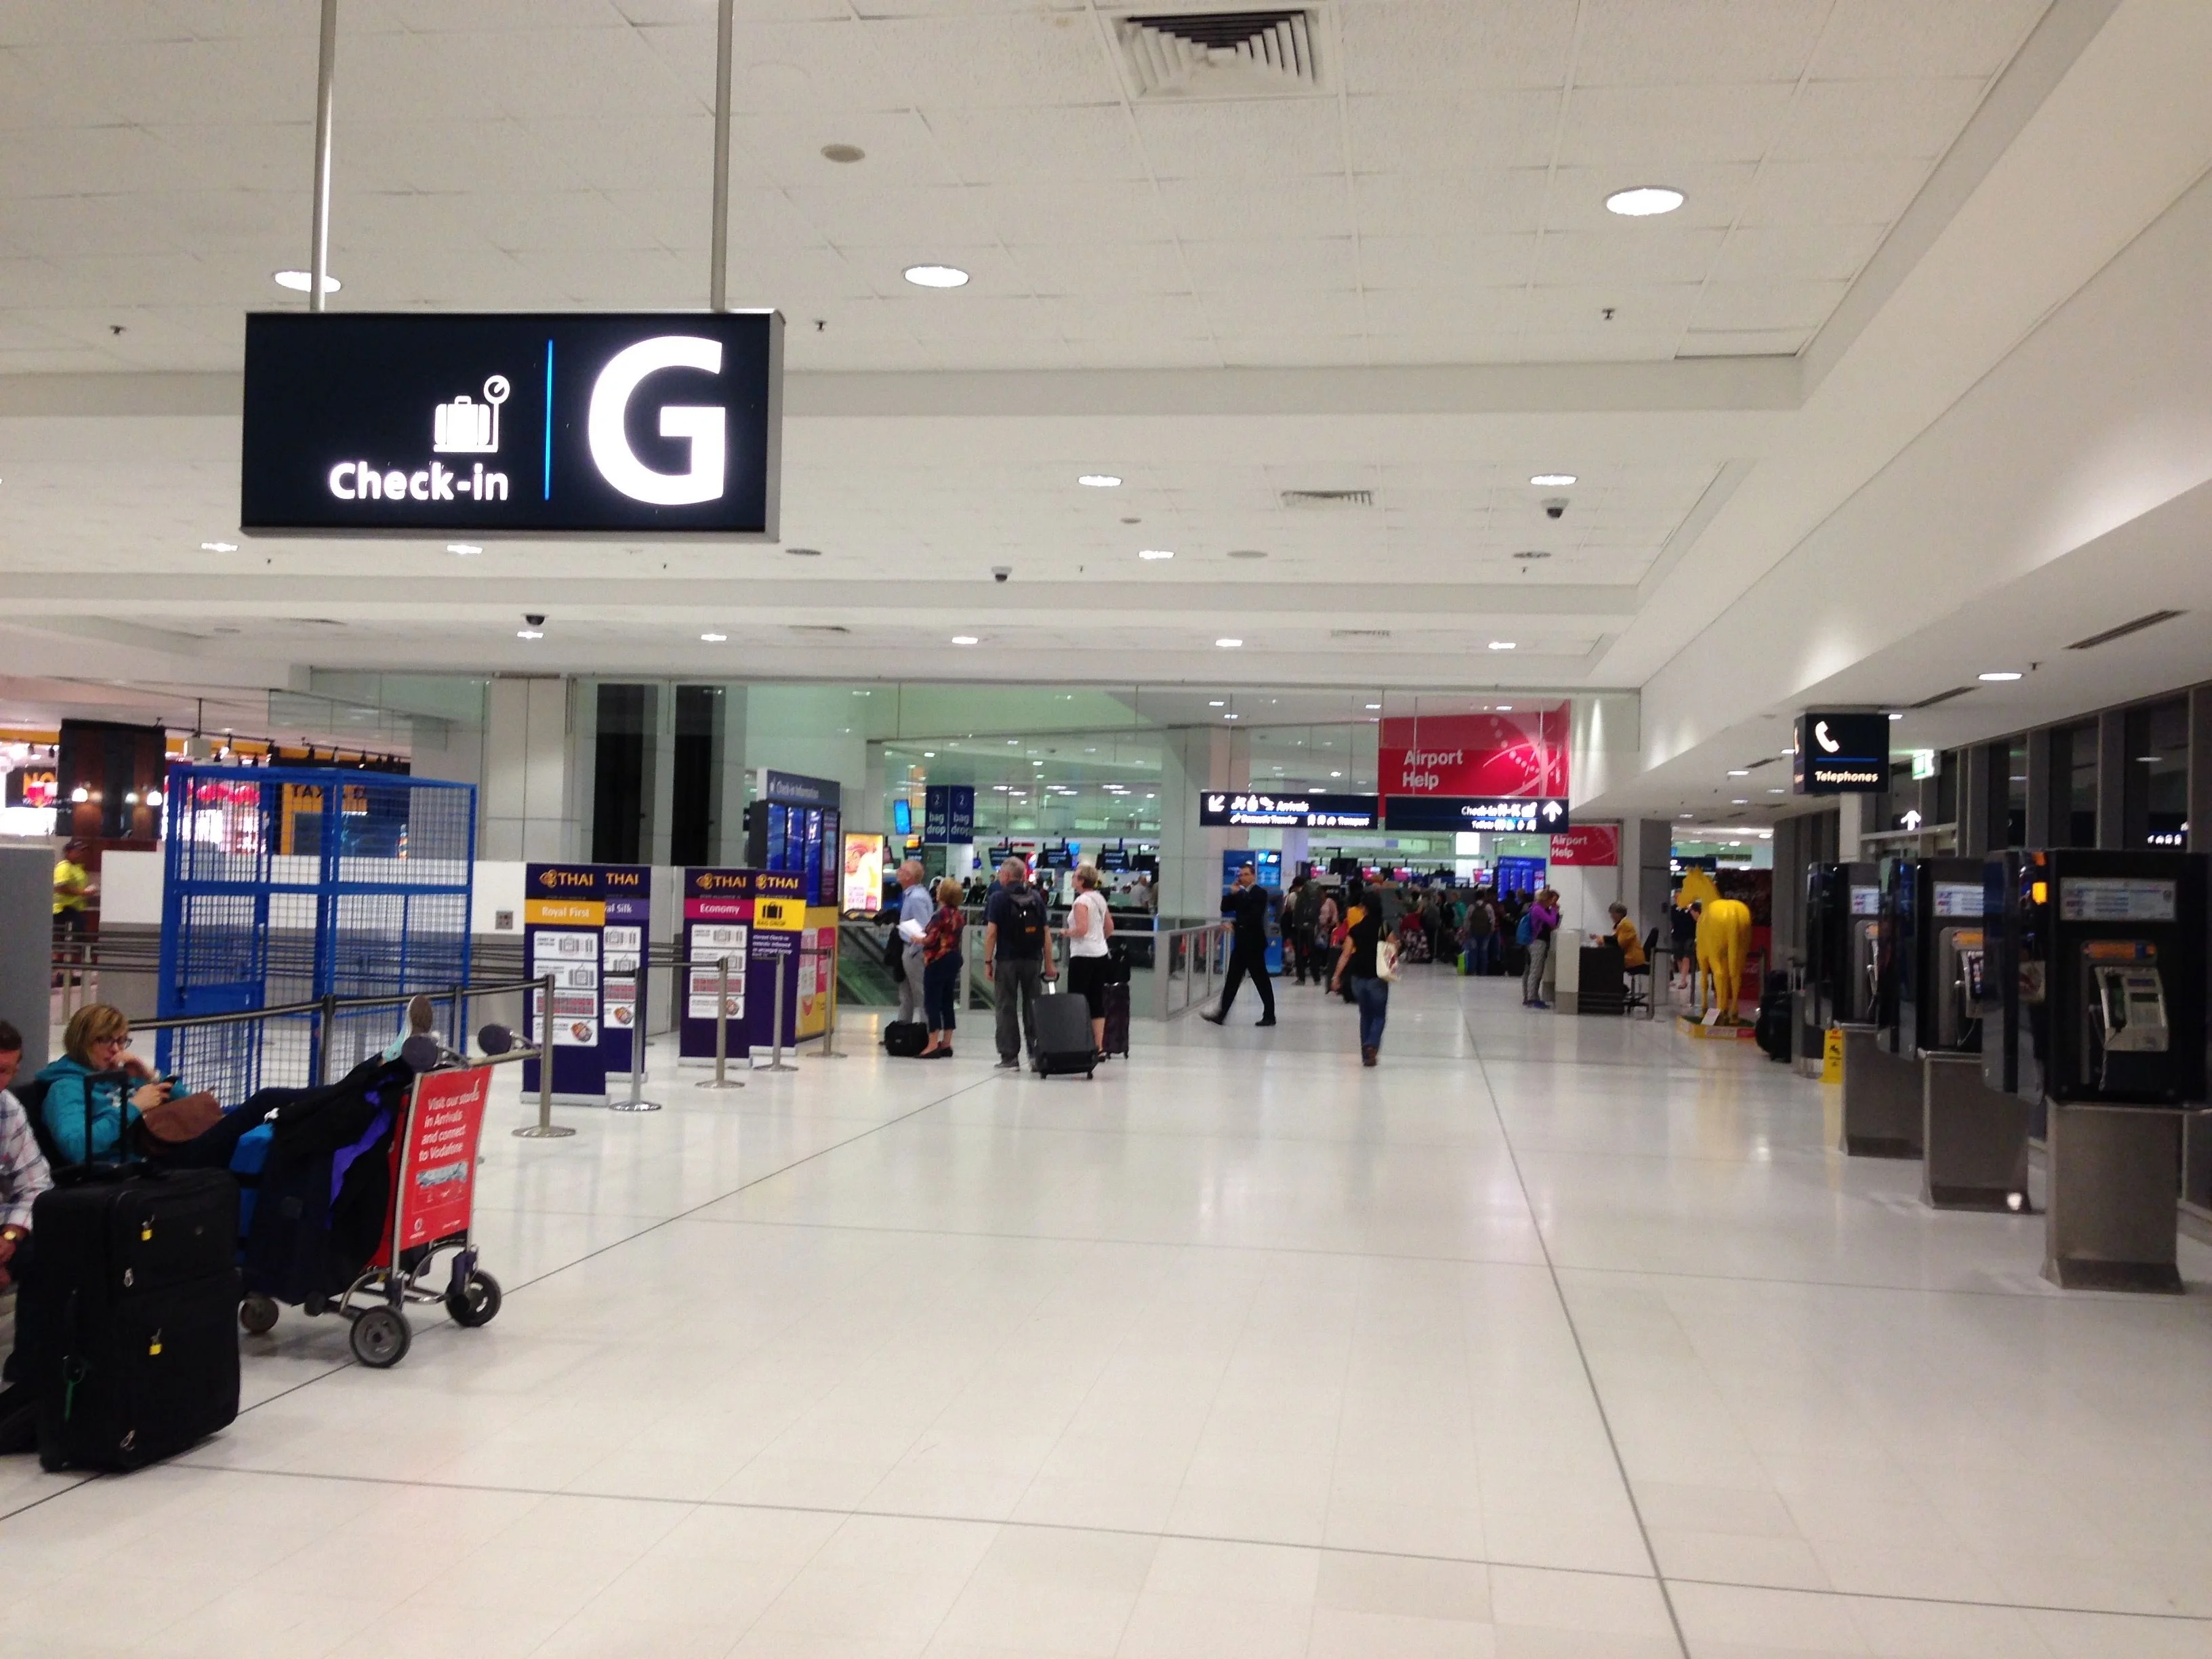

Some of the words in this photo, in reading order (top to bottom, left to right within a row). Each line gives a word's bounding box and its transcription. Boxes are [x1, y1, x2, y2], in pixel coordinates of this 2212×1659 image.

[588, 335, 726, 506] G
[329, 461, 508, 501] Check-in
[1404, 748, 1463, 766] Airport
[1402, 771, 1439, 790] Help
[1815, 771, 1879, 783] Telephones
[929, 811, 944, 825] bag
[954, 812, 969, 825] bag
[927, 824, 946, 837] drop
[1552, 836, 1588, 847] Airport
[1551, 848, 1574, 859] Help
[558, 872, 594, 886] THAI
[606, 872, 639, 885] THAI
[713, 875, 746, 888] THAI
[766, 876, 799, 889] THAI
[542, 907, 567, 918] Royal
[569, 907, 590, 918] First
[616, 903, 632, 914] Silk
[699, 903, 741, 915] Economy
[422, 1129, 439, 1145] and
[419, 1150, 430, 1162] to
